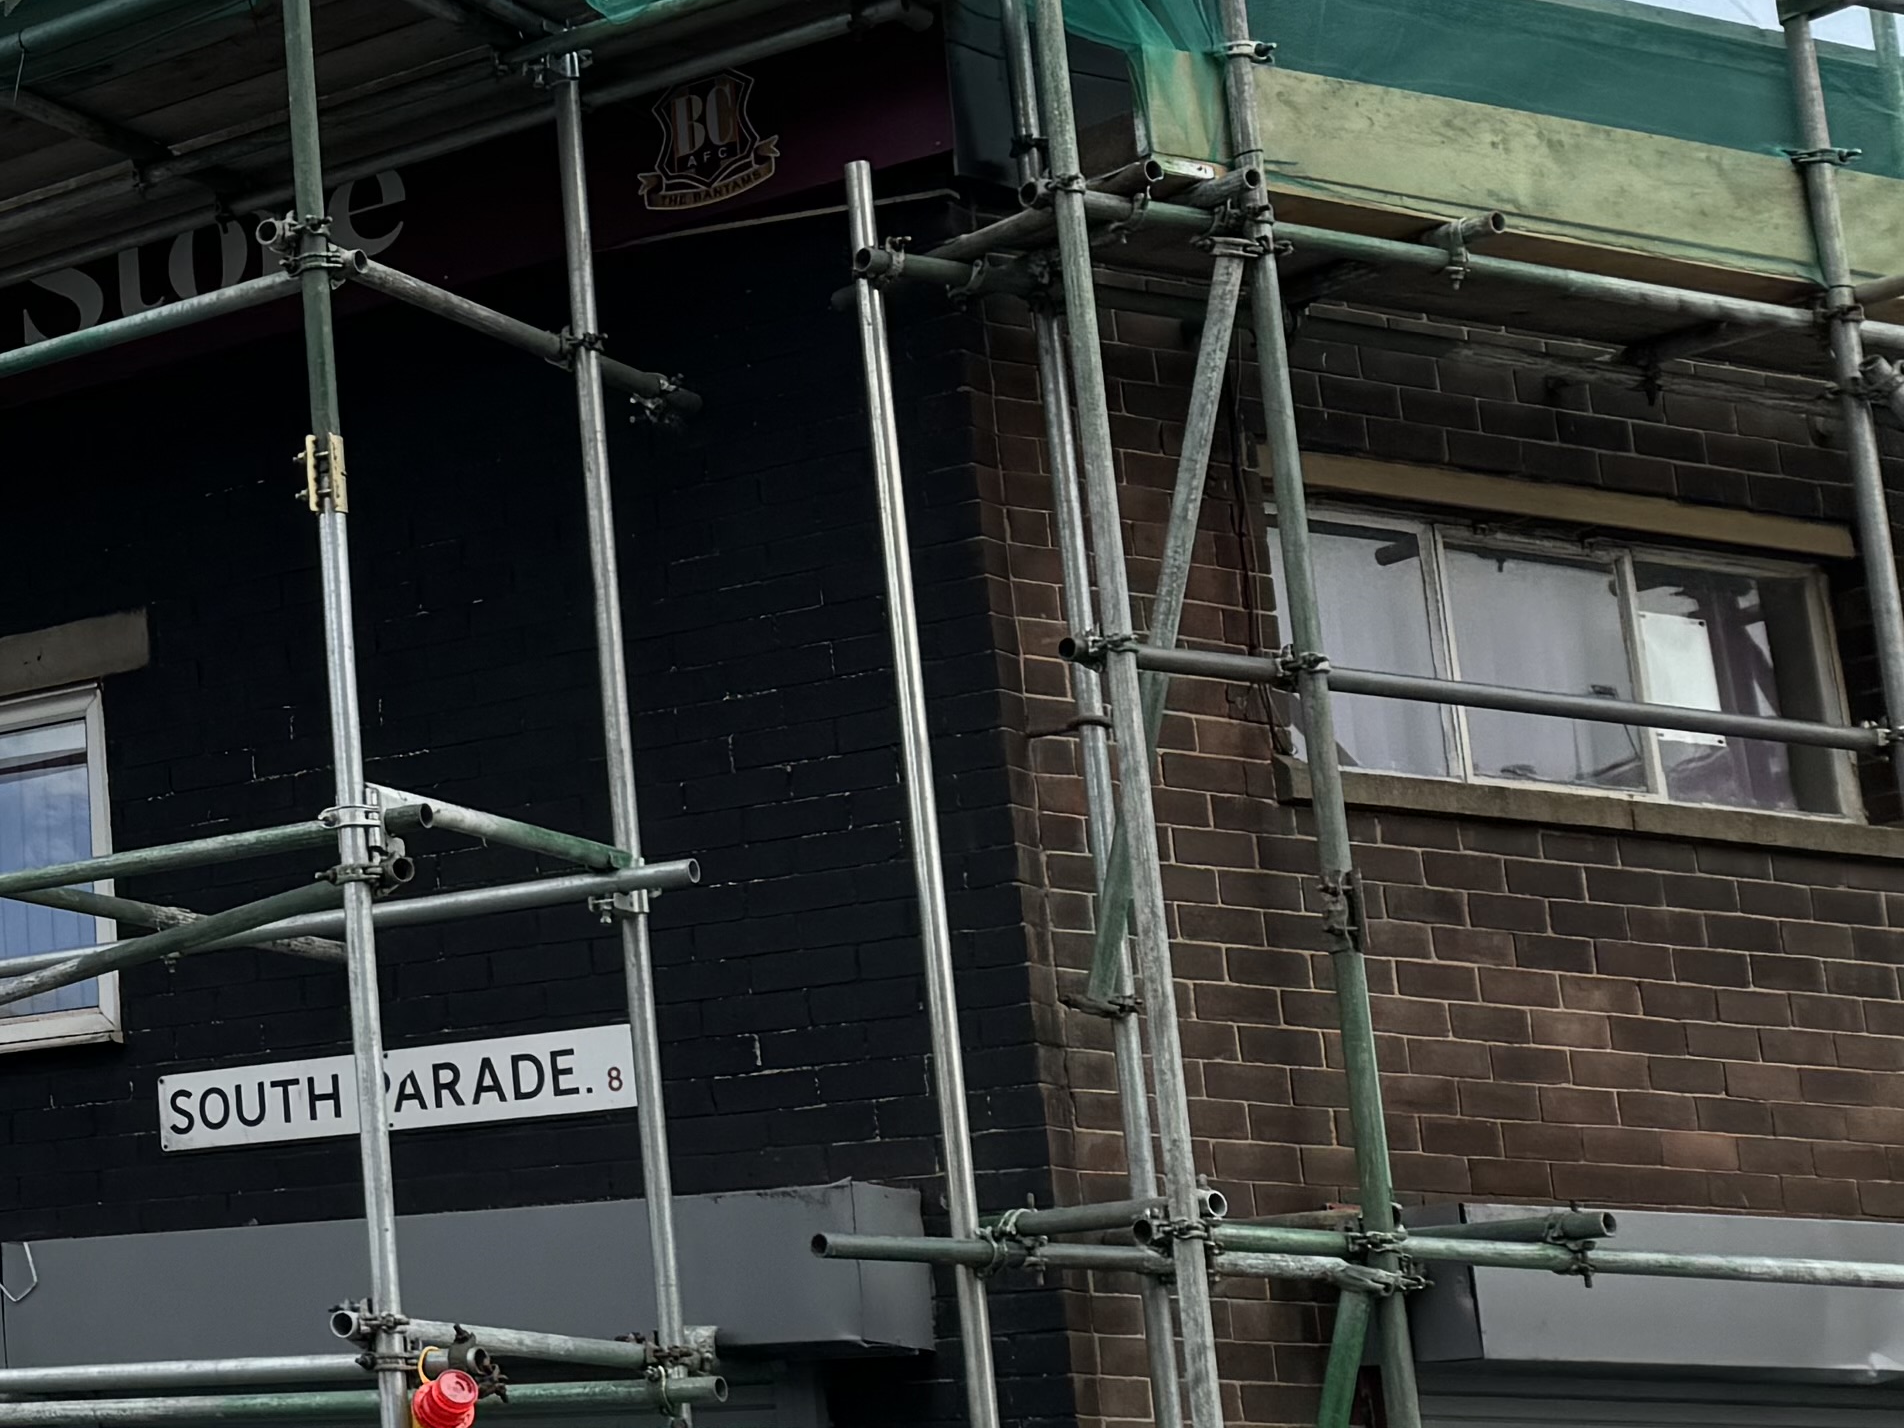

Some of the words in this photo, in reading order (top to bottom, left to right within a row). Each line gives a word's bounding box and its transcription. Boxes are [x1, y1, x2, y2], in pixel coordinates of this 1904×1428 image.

[168, 1073, 343, 1136] SOUTH
[382, 1048, 594, 1113] ARADE.
[607, 1066, 624, 1092] 8
